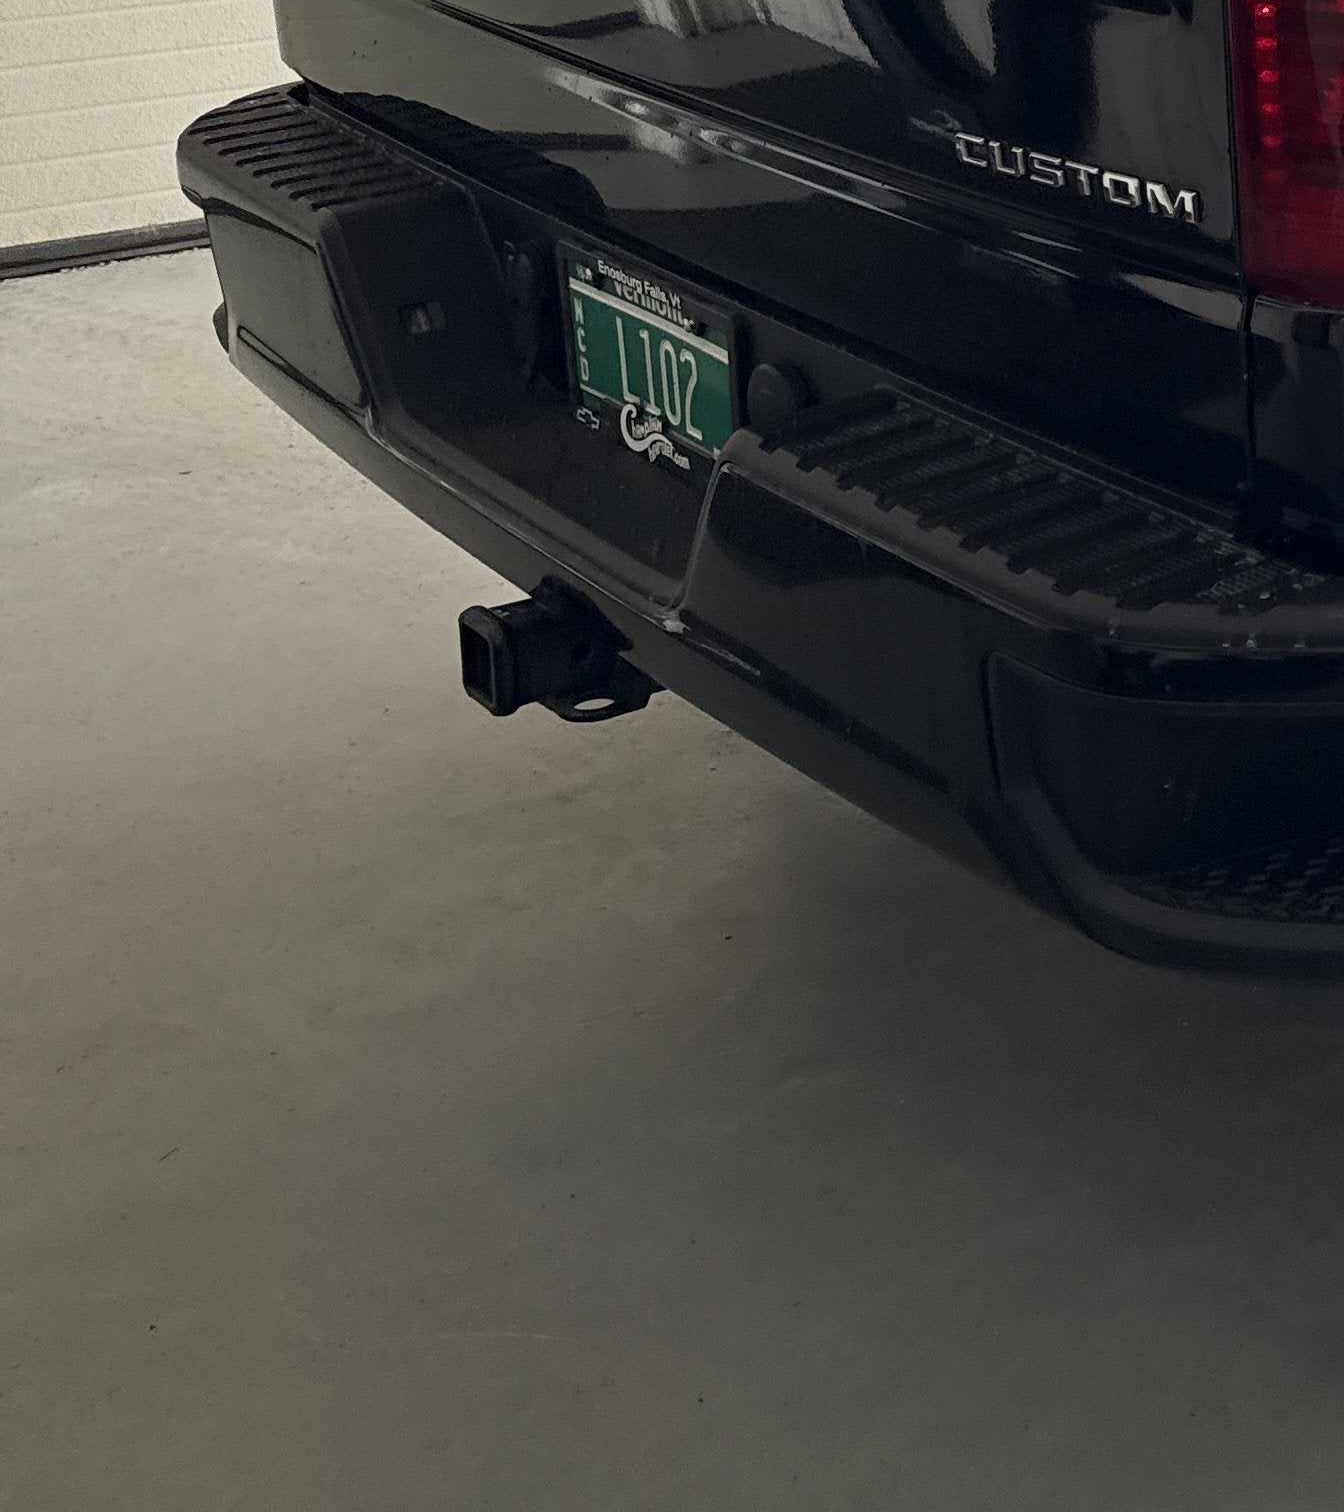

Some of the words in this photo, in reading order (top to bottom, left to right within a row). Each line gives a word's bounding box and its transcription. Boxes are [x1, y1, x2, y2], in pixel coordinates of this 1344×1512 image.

[955, 131, 1198, 225] CUSTOM
[597, 259, 643, 295] Enosburg
[616, 315, 703, 441] L102
